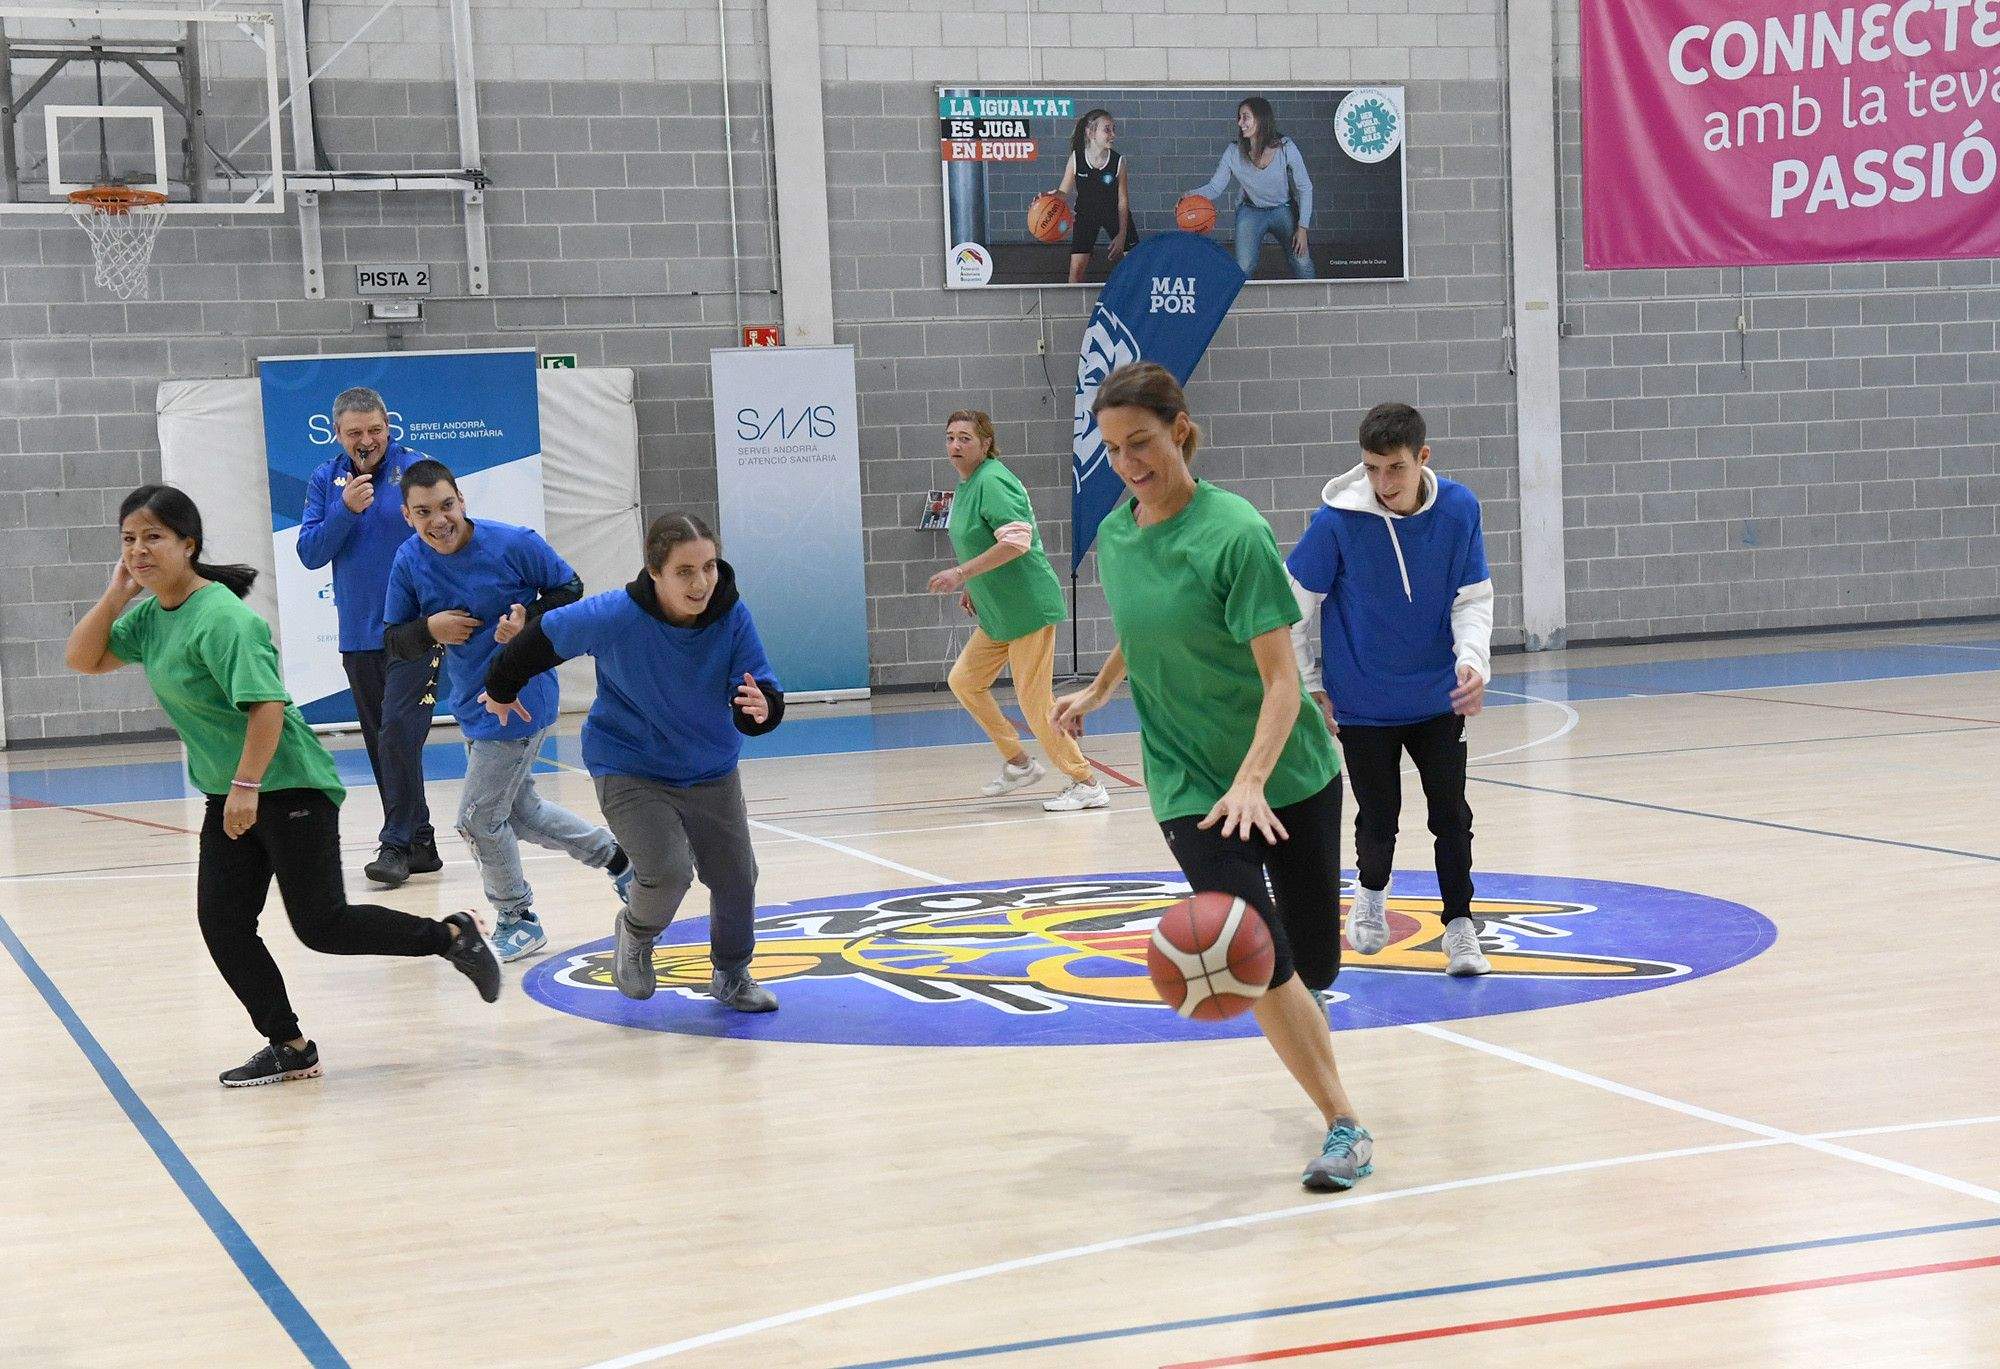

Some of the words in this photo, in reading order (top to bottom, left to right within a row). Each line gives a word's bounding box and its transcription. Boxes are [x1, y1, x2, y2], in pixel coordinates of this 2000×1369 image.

[949, 99, 975, 116] LA
[980, 99, 1071, 117] IGUALTAT
[1703, 85, 1822, 152] amb
[1842, 76, 1888, 129] la
[950, 120, 974, 138] ES
[978, 120, 1027, 138] JUGA
[952, 142, 977, 159] EN
[981, 142, 1035, 161] EQUIP
[1770, 119, 1998, 218] PASSIÓ
[1040, 203, 1060, 230] molten
[360, 271, 409, 287] PISTA
[416, 271, 427, 286] 2
[1151, 276, 1196, 295] MAI
[1150, 295, 1196, 314] POR
[308, 411, 404, 445] SS
[409, 422, 440, 431] SERVEI
[443, 419, 486, 430] ANDORRÀ
[737, 405, 836, 441] SAAS
[410, 430, 457, 441] D'ATENCIÓ
[459, 428, 504, 439] SANITÀRIA
[738, 446, 770, 455] SERVEI
